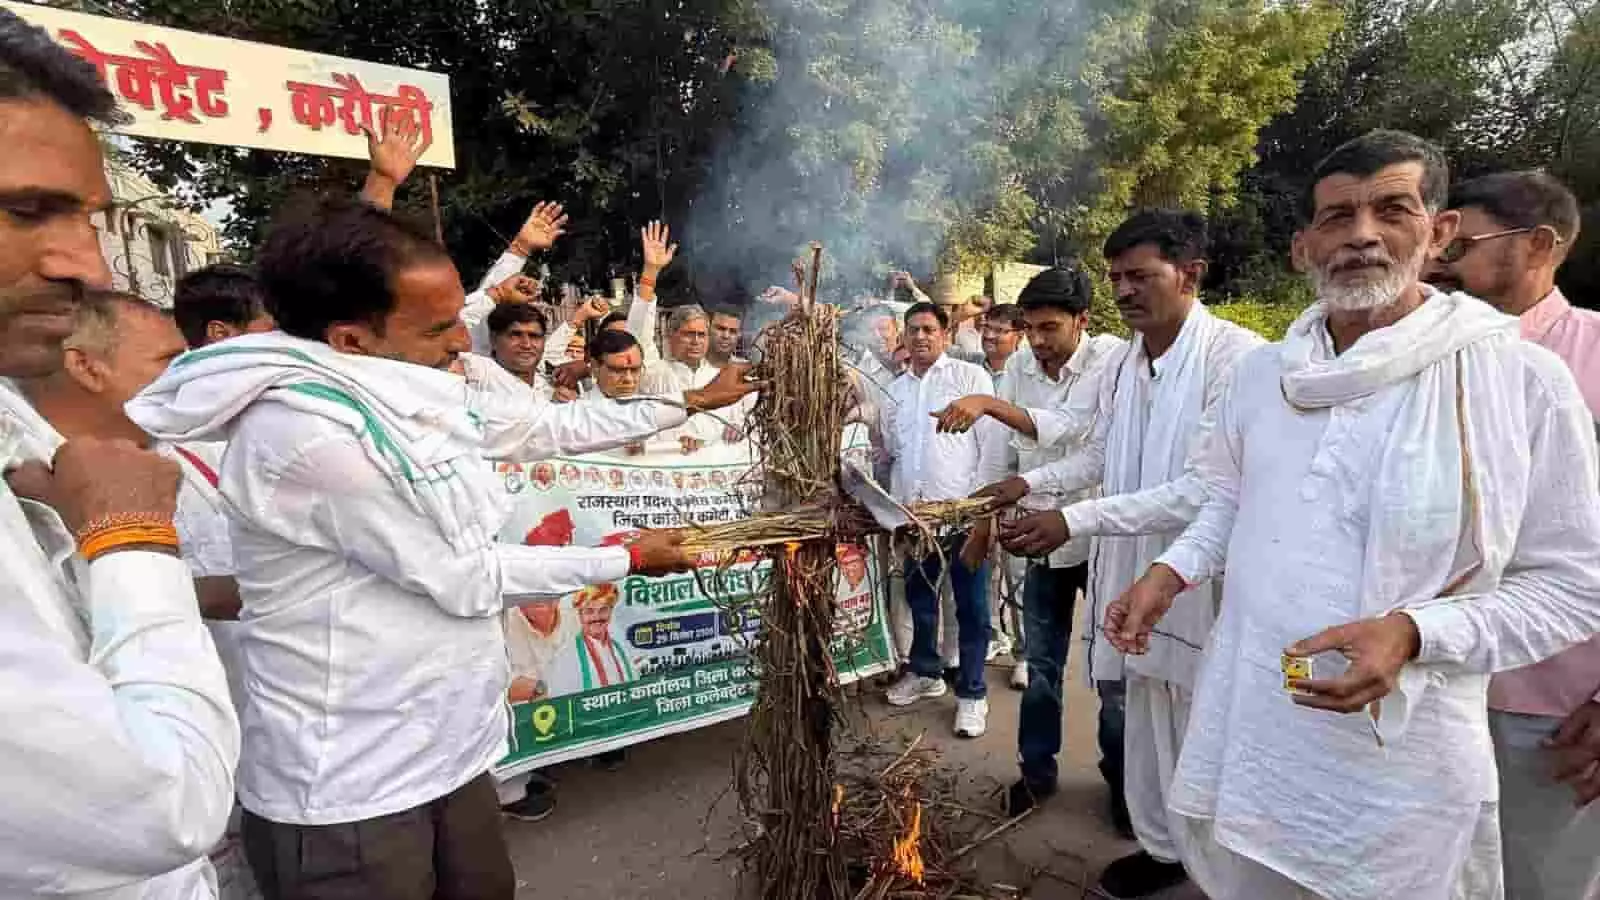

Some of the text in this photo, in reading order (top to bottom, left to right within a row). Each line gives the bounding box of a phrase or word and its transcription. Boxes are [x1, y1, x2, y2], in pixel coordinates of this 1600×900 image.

[576, 495, 640, 511] राजस्थान
[624, 575, 694, 607] विशाल
[630, 675, 692, 700] कार्यालय
[694, 667, 729, 687] जिला
[655, 696, 691, 715] जिला
